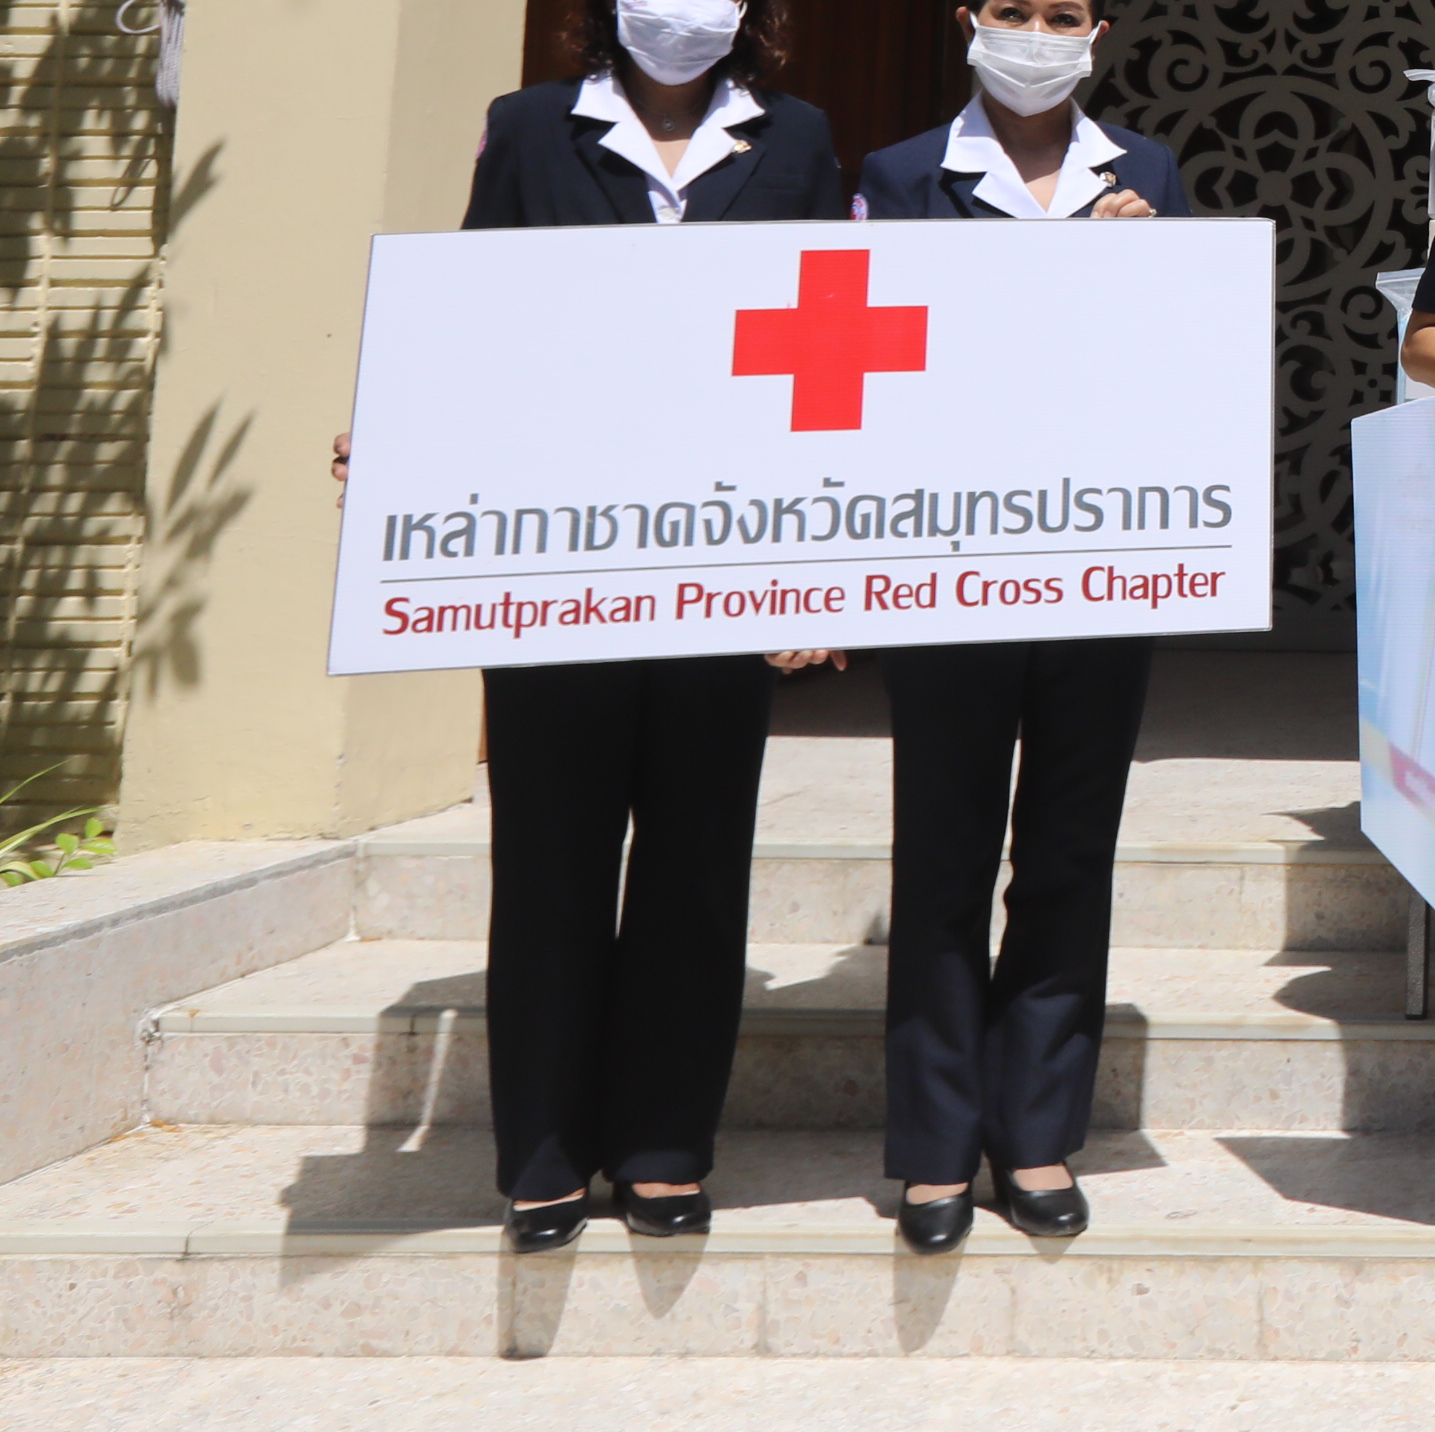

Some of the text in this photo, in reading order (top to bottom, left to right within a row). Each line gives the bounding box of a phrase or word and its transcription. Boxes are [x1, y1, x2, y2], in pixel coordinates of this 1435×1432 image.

[382, 477, 1232, 561] เหล่ากาชาดจังหวัดสมุทรปราการ
[382, 563, 1226, 639] Samutprakan Province Red Cross Chapter
